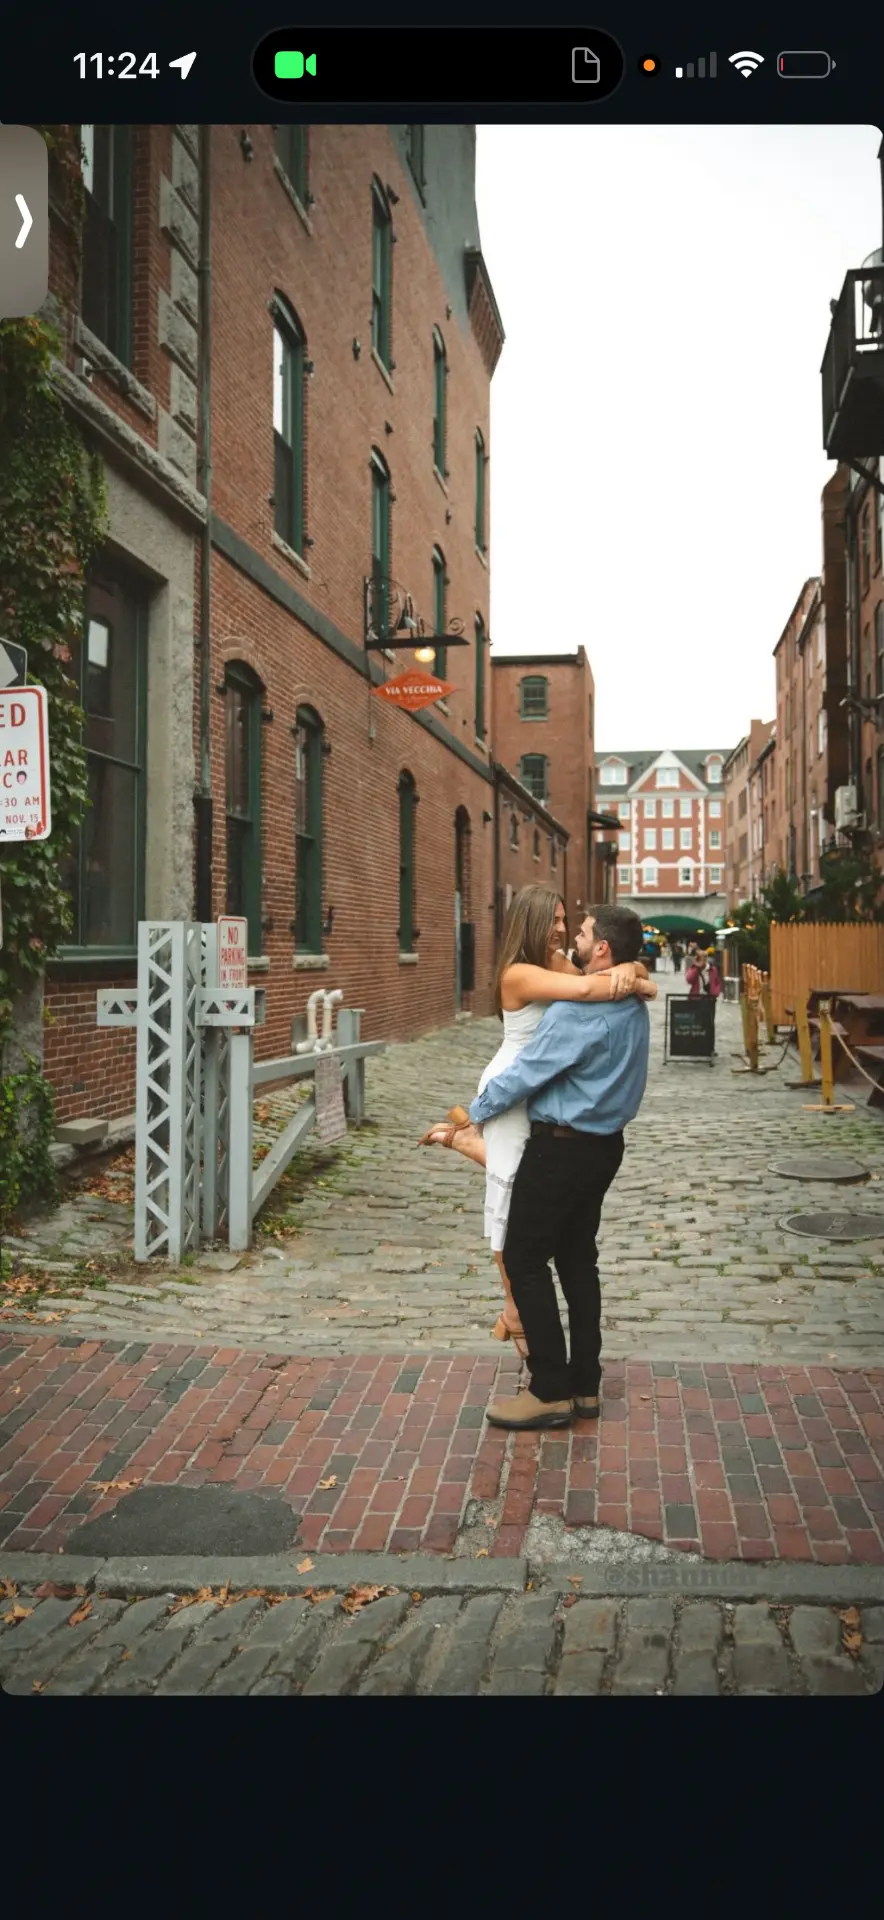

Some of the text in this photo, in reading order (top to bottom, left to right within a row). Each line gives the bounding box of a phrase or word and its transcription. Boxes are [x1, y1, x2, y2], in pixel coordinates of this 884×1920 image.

[385, 687, 400, 695] VIA
[0, 749, 28, 767] AR
[24, 795, 40, 807] AM
[228, 926, 239, 945] NO
[222, 948, 245, 965] PARKING
